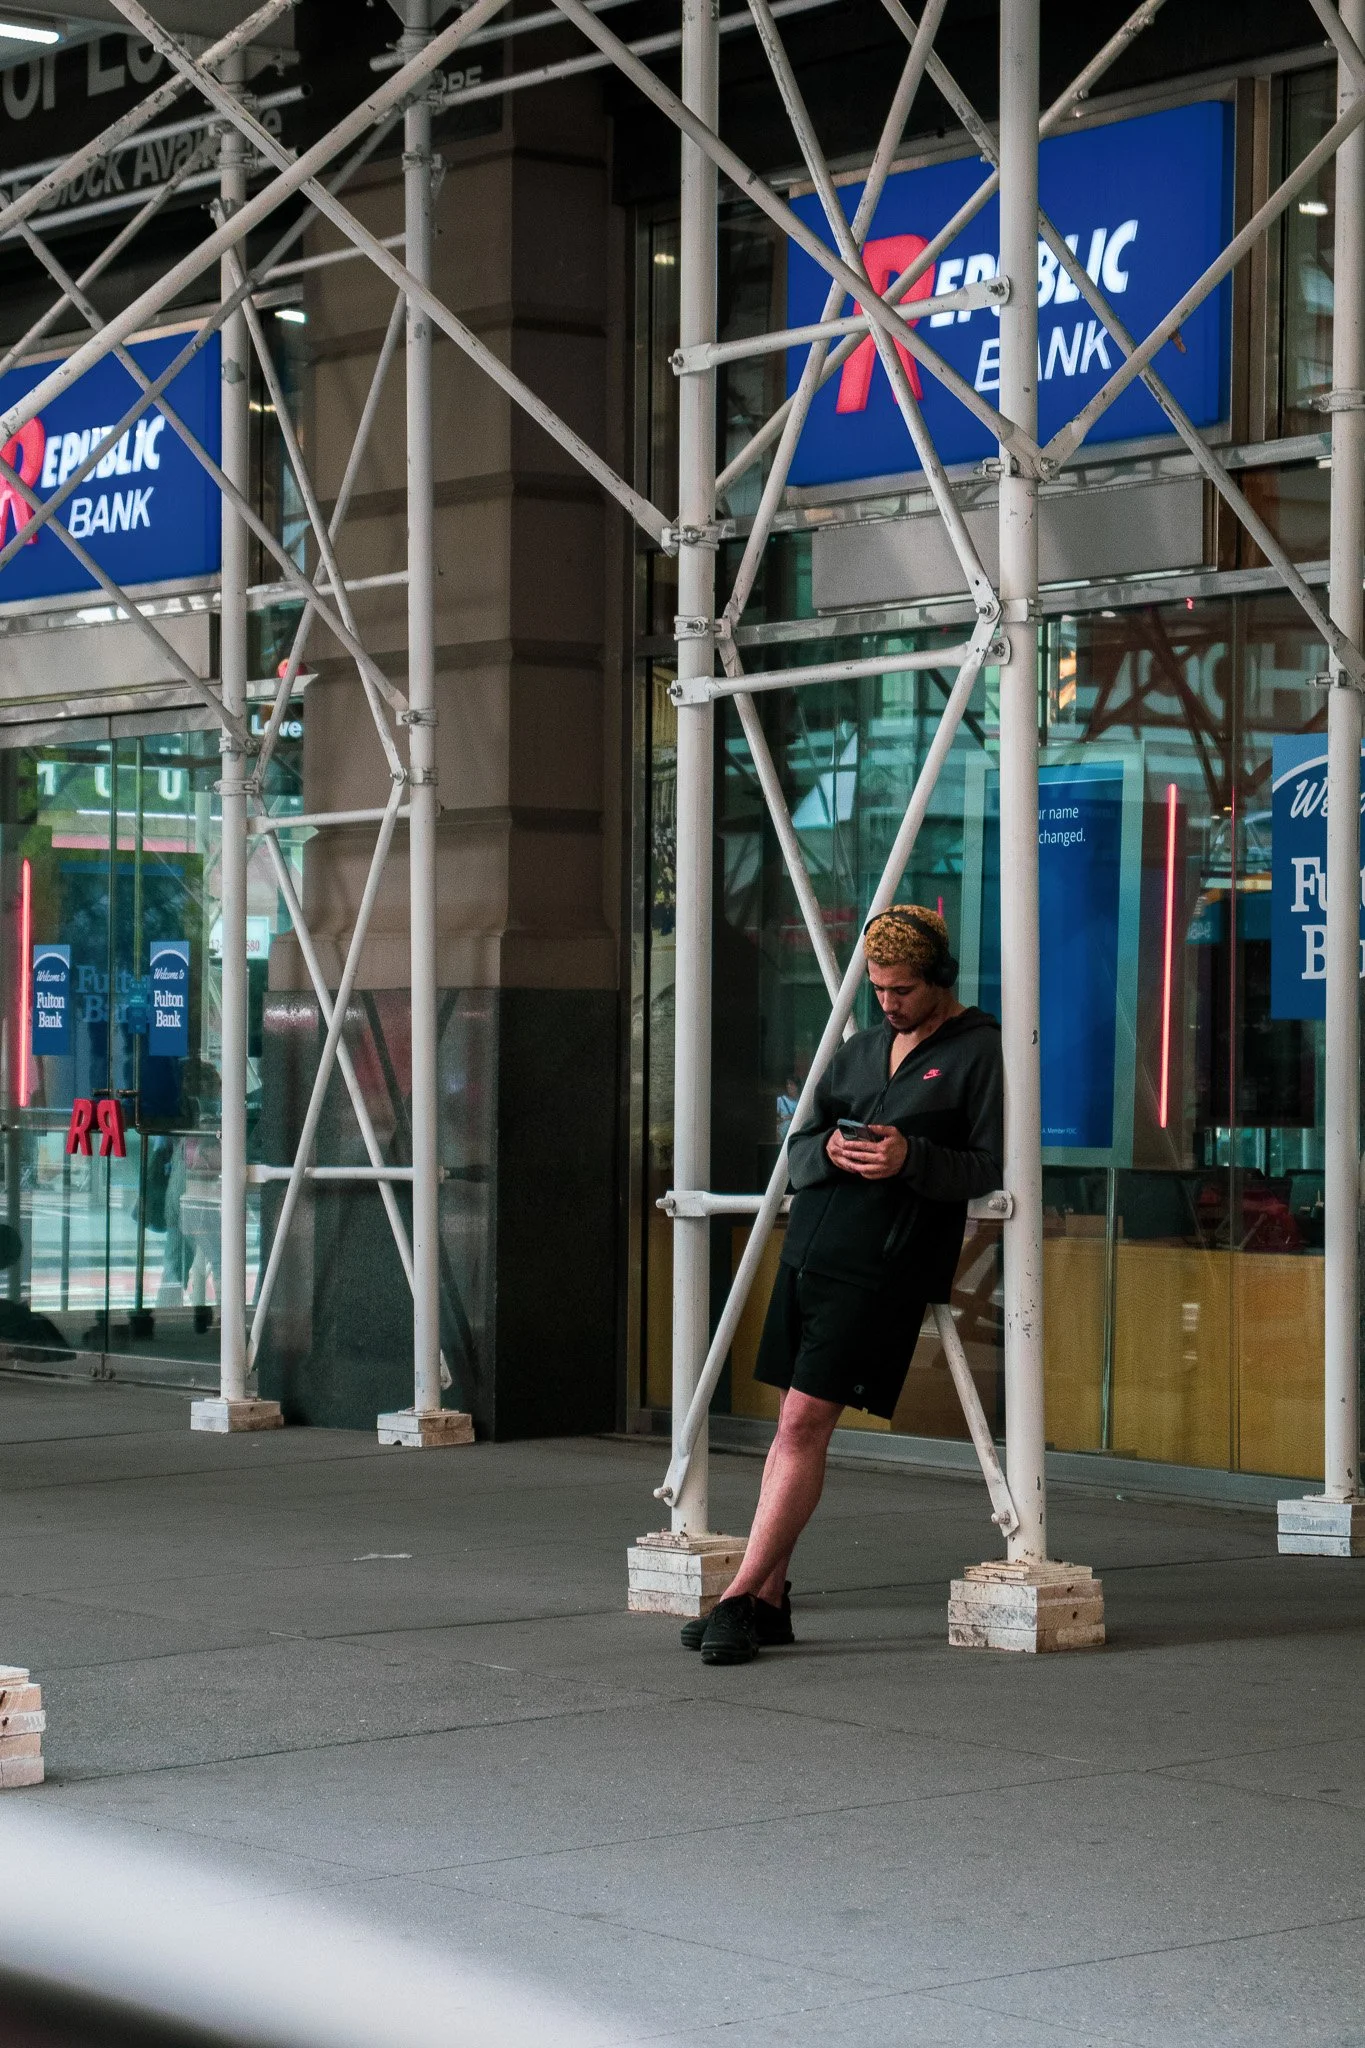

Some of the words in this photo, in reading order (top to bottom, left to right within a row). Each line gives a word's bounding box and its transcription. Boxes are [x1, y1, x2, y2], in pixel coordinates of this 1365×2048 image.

[974, 319, 1112, 393] BNK
[67, 486, 155, 539] BANK
[1049, 806, 1079, 820] name
[1038, 827, 1087, 848] changed.
[36, 969, 60, 983] Welcome
[60, 971, 66, 983] to
[154, 967, 179, 980] Welcome
[178, 968, 185, 980] to
[36, 991, 65, 1009] Fulton
[153, 990, 184, 1008] Fulton
[38, 1011, 63, 1028] Bank
[155, 1010, 182, 1028] Bank
